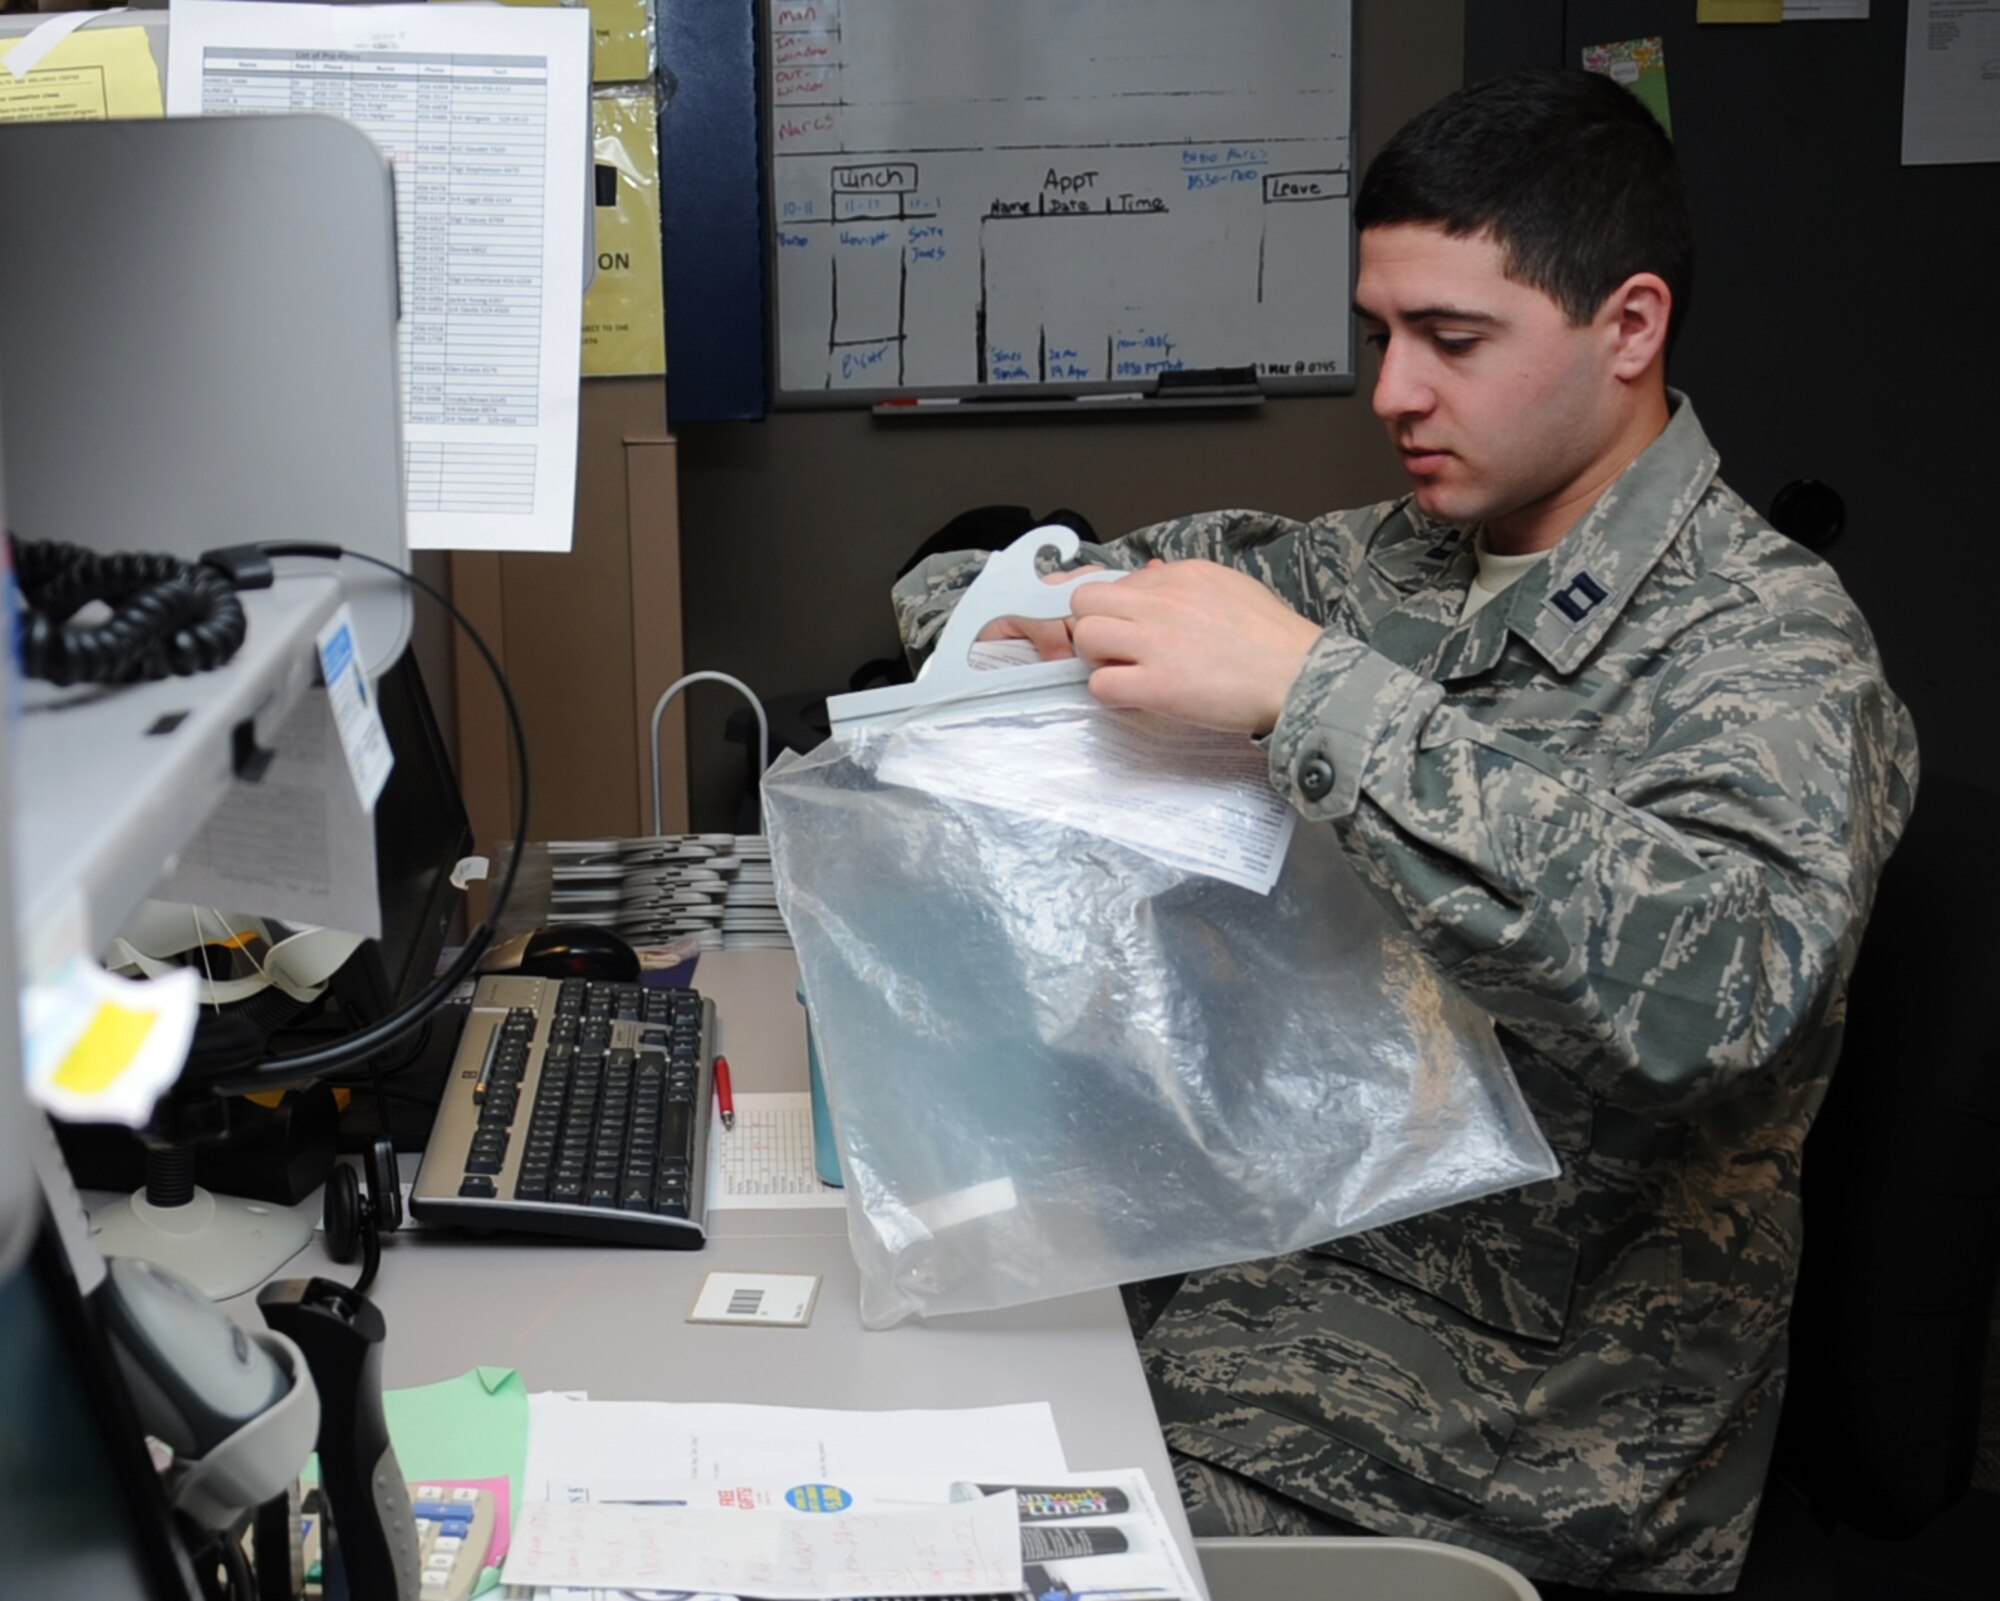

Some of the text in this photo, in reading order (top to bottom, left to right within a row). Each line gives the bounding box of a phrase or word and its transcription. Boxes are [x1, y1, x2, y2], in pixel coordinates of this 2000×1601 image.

[1272, 179, 1322, 198] Leave
[991, 194, 1165, 214] Name Date Time
